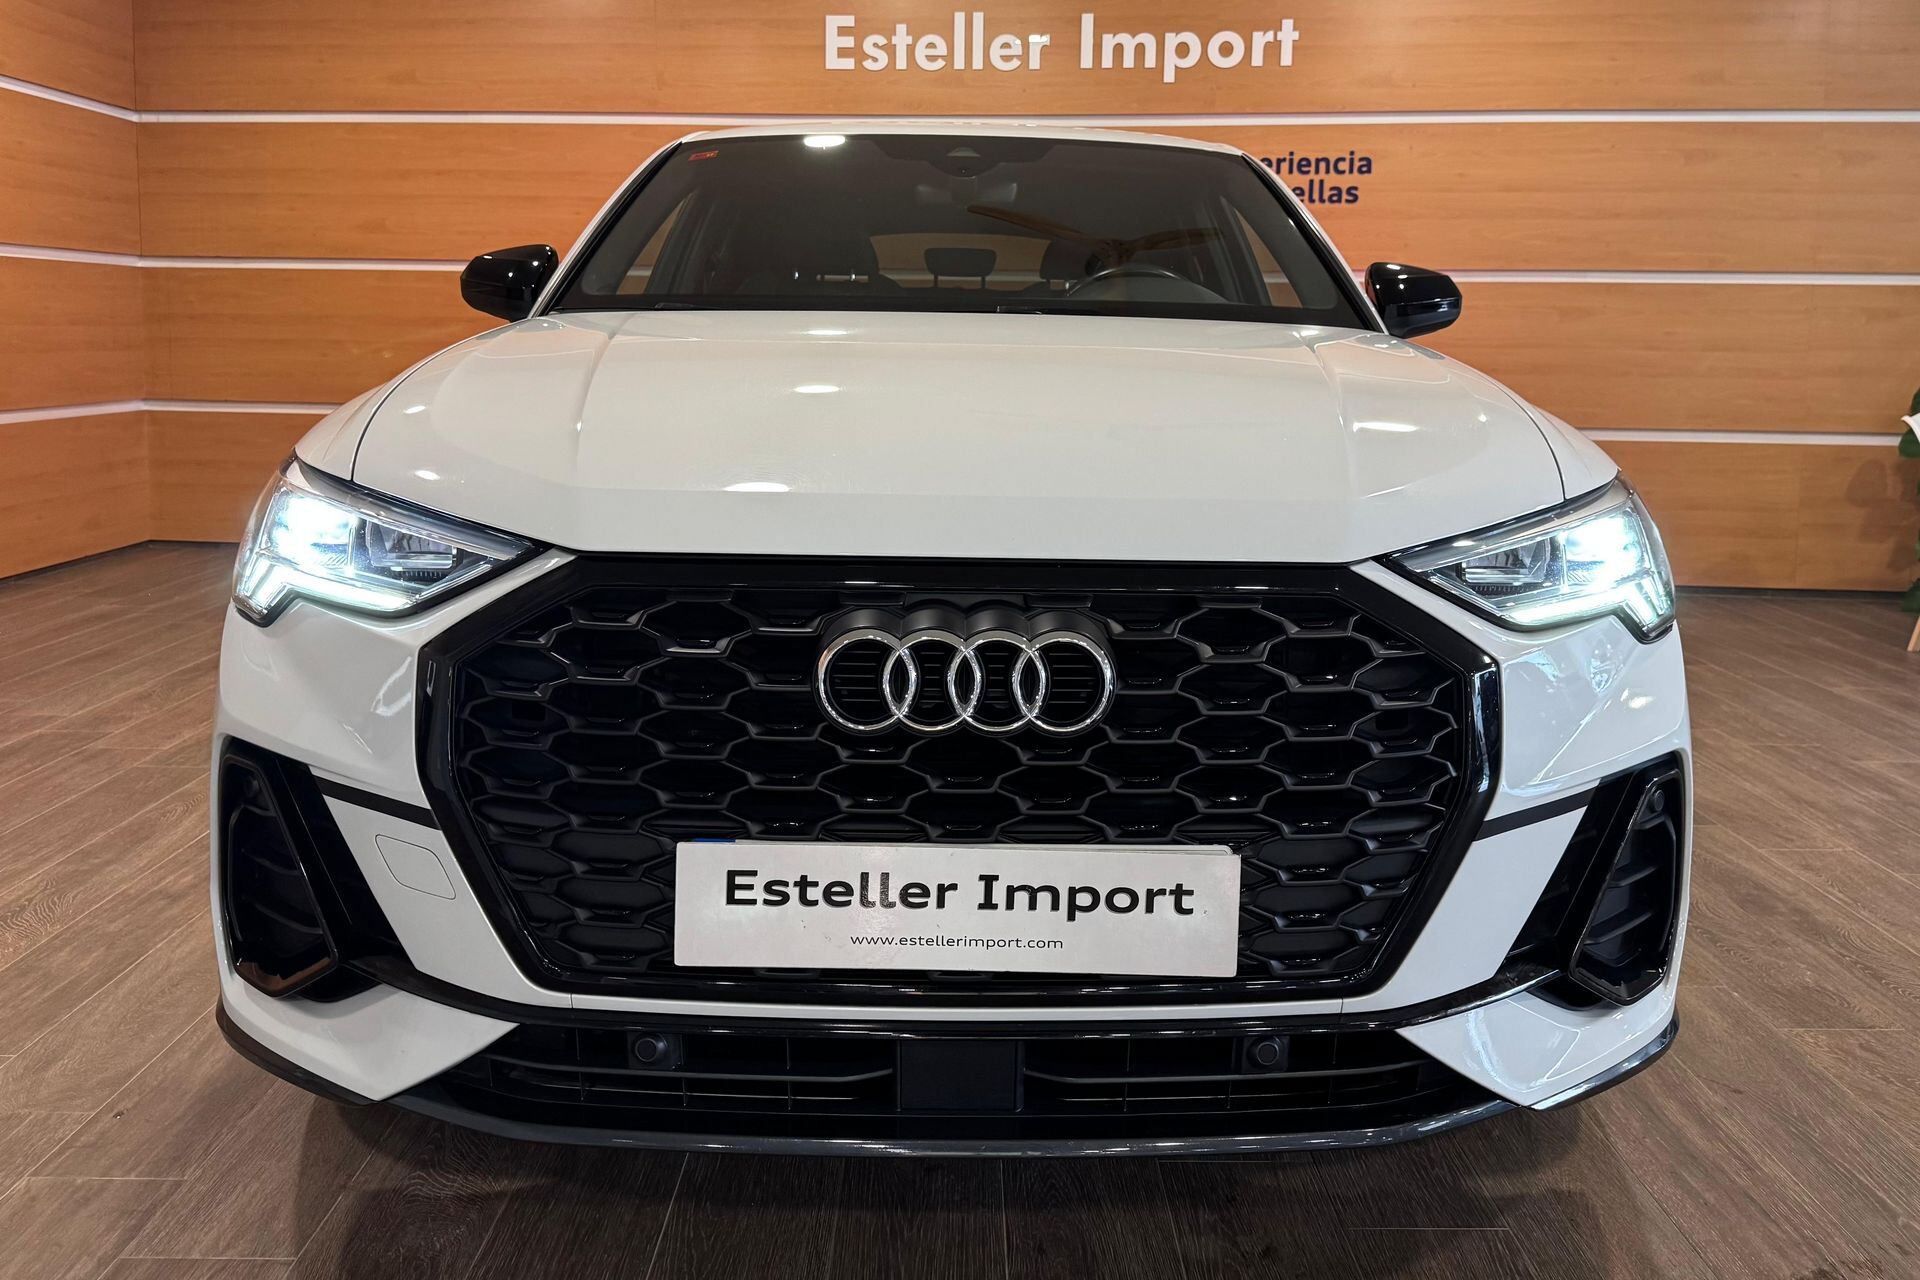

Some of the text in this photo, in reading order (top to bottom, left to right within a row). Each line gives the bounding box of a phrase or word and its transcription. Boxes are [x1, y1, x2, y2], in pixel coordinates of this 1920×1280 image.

[825, 12, 1299, 83] Esteller Import
[725, 869, 1195, 922] Esteller Import
[850, 935, 1064, 951] www.estellerimport.com
